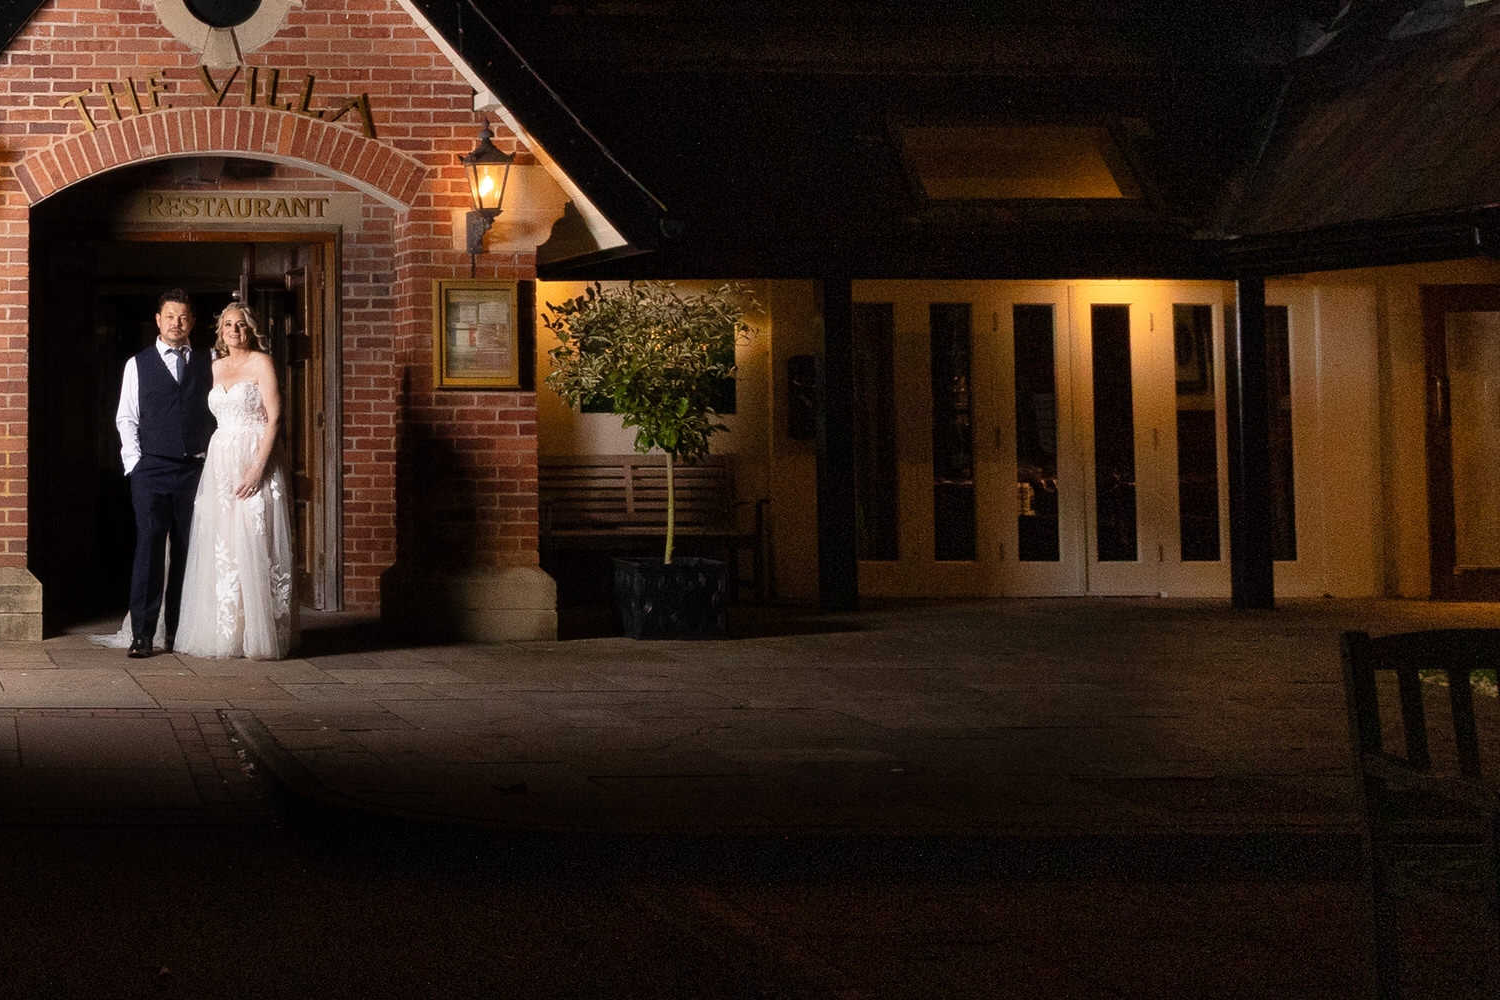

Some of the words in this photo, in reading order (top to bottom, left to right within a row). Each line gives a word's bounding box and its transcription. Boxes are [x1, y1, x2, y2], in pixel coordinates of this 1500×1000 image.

[59, 71, 173, 131] THE
[198, 65, 377, 139] VILLA
[148, 195, 329, 218] RESTAURANT
